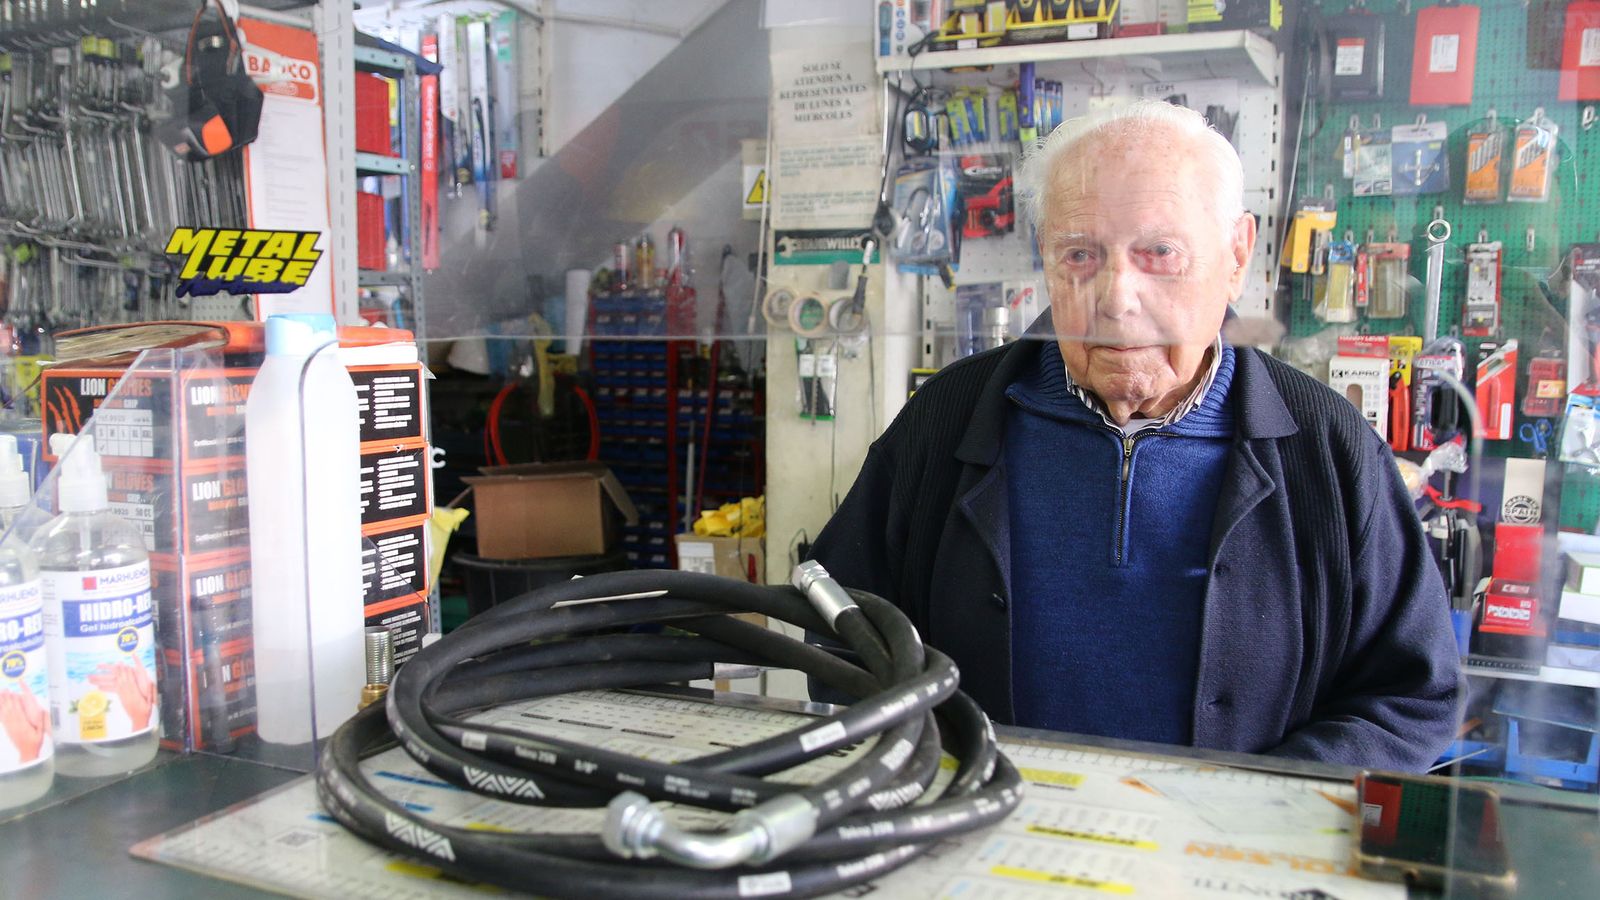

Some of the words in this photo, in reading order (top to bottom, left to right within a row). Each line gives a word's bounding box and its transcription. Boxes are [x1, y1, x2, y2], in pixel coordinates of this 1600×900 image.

[248, 55, 311, 81] BACO
[166, 227, 324, 256] METAL
[81, 378, 106, 396] LION
[192, 480, 221, 500] LION
[196, 574, 223, 597] LION
